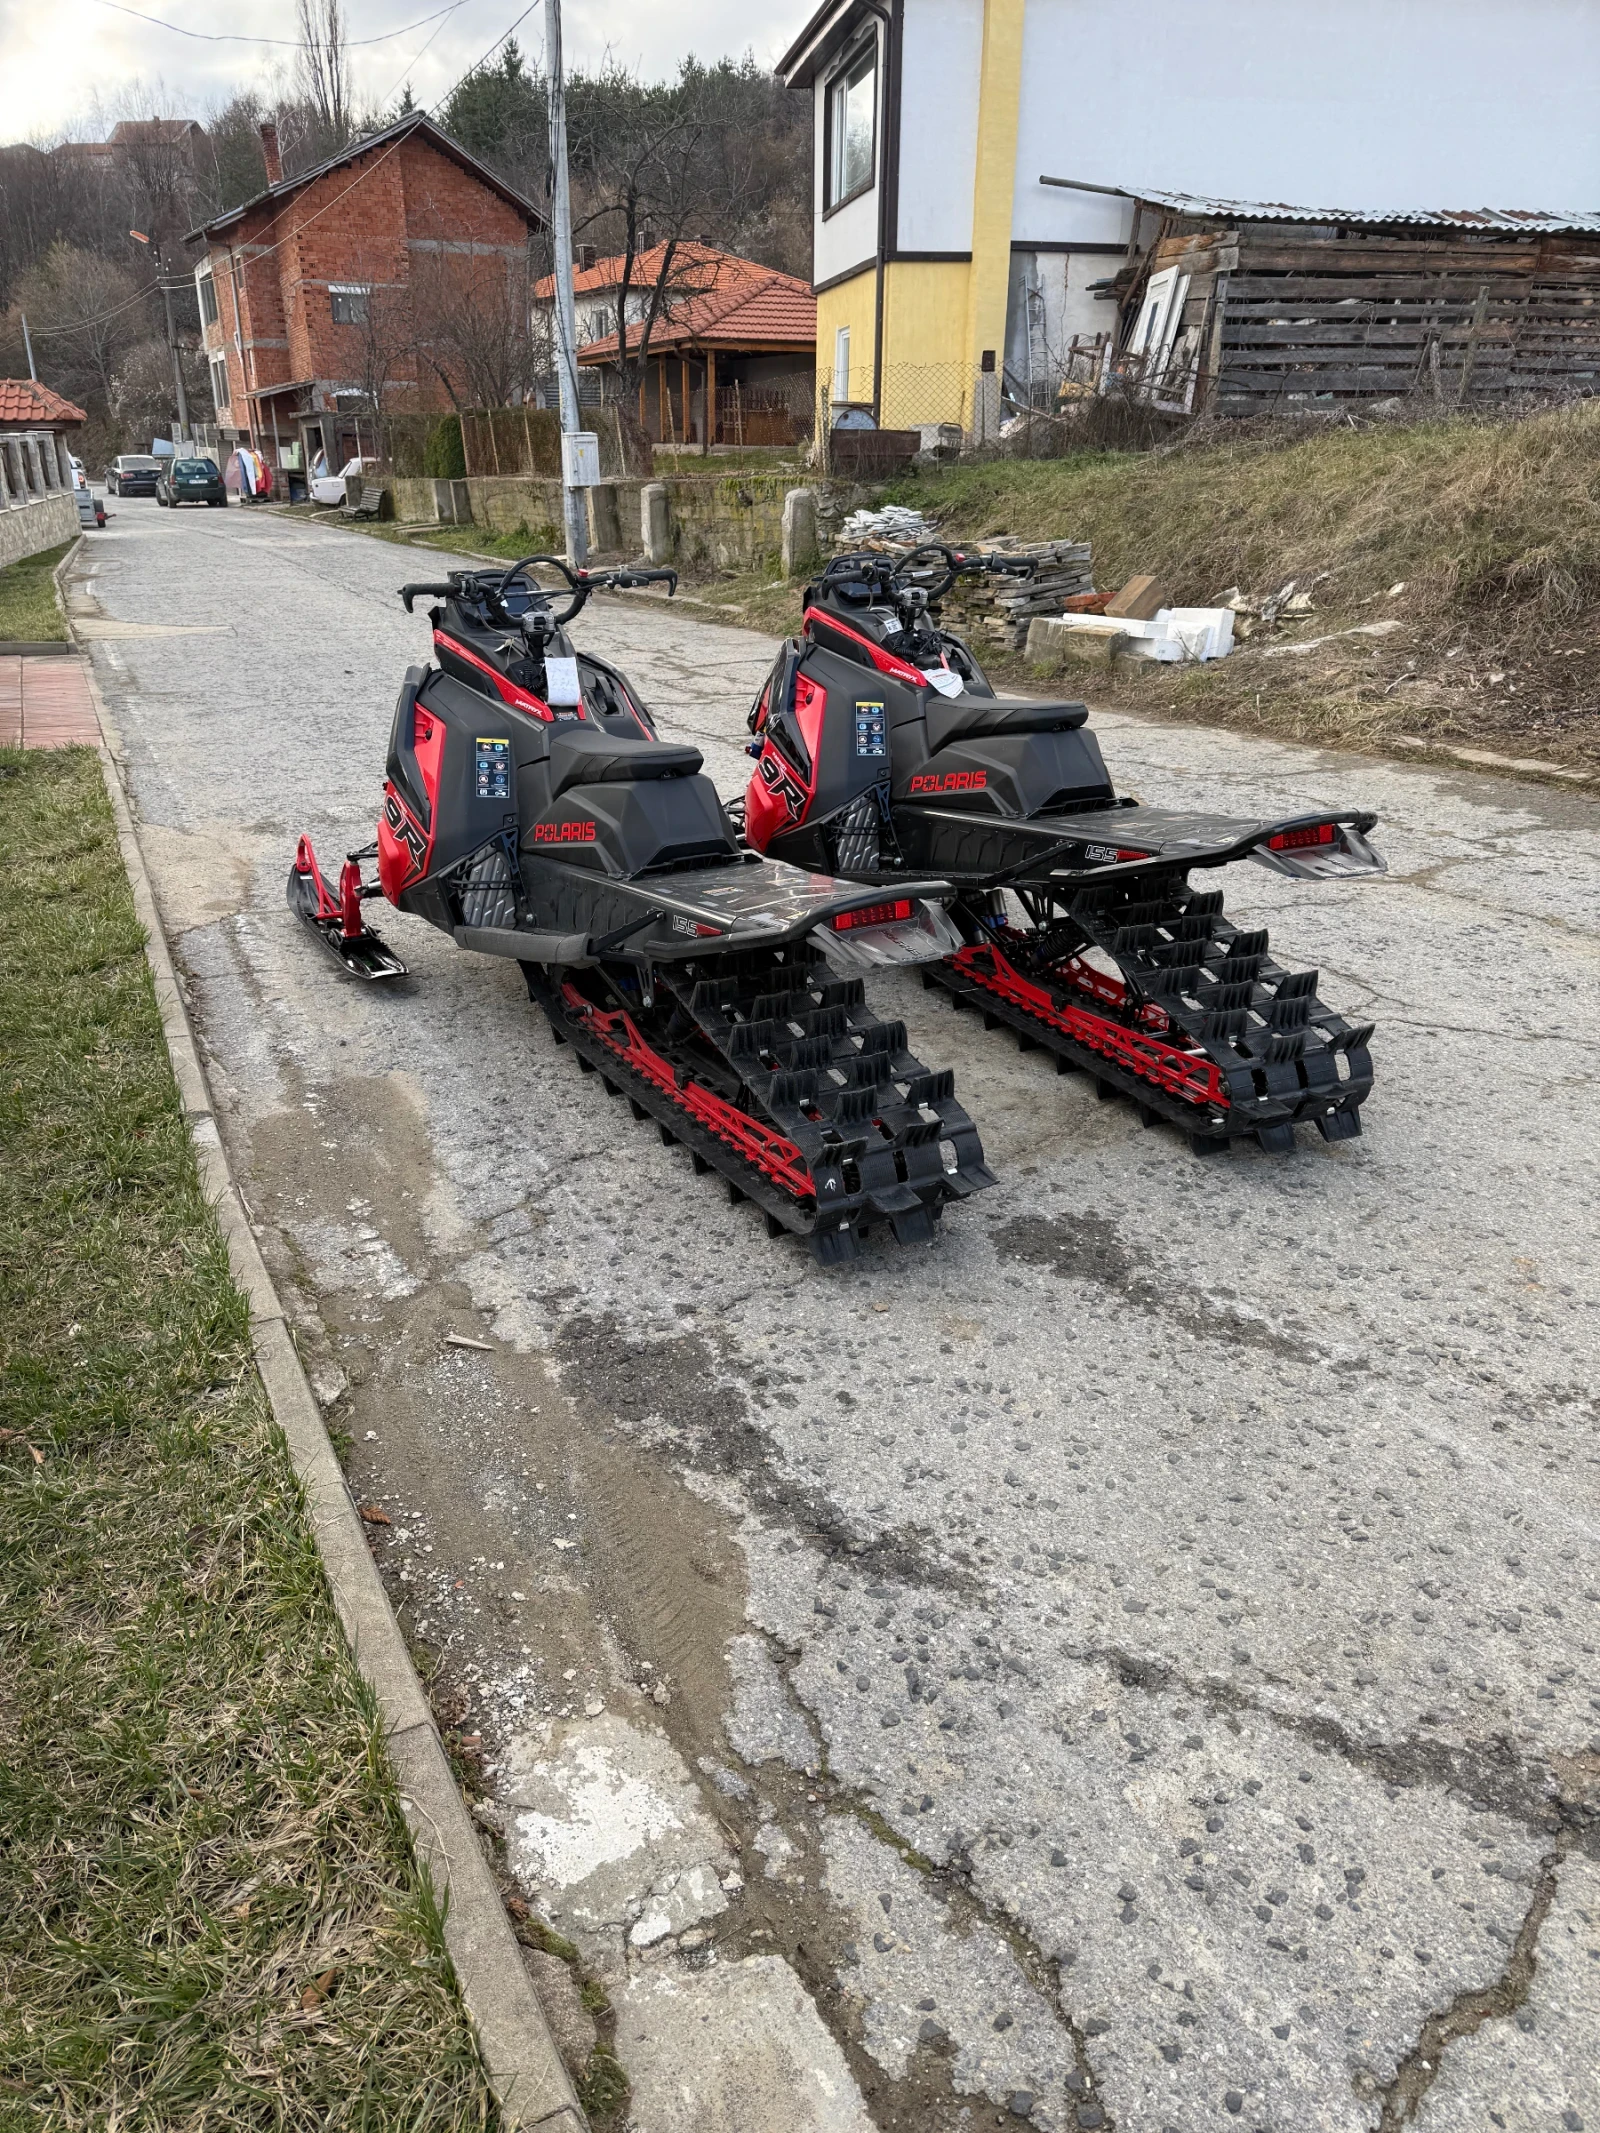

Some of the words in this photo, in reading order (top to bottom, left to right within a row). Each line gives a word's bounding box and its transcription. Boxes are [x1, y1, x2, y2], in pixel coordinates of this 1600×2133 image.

[758, 754, 806, 821] 9R
[910, 771, 987, 792] POLARIS
[534, 822, 596, 842] POLARIS
[1085, 845, 1119, 863] 155
[672, 914, 699, 938] 155
